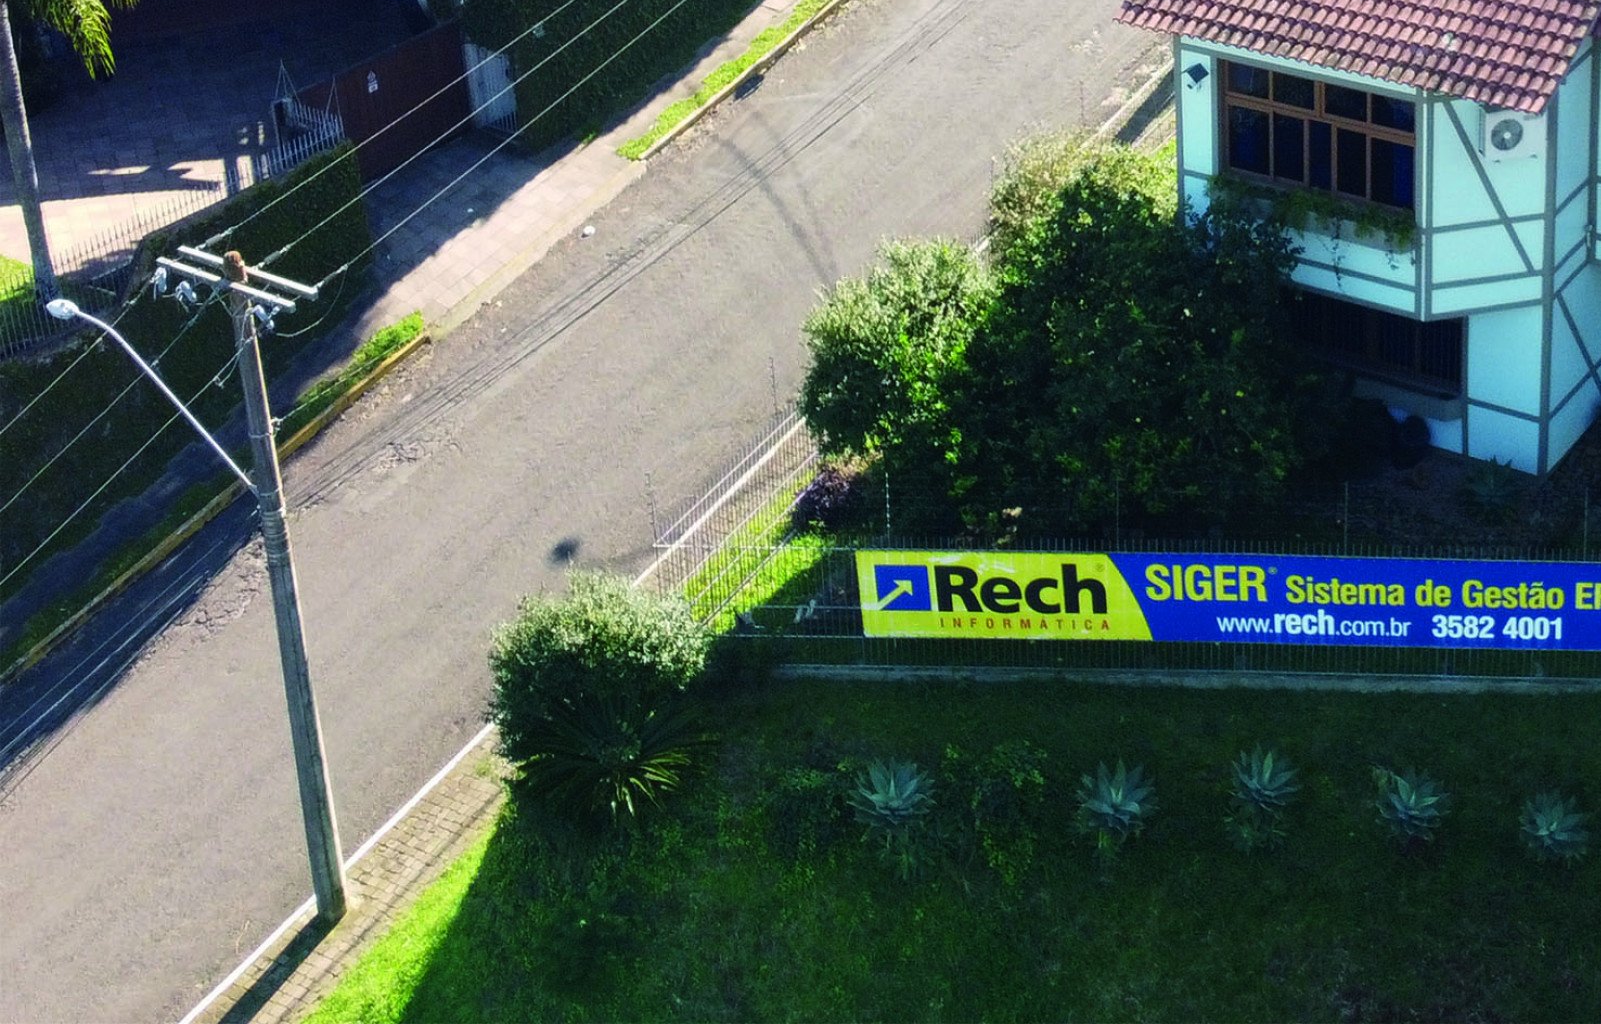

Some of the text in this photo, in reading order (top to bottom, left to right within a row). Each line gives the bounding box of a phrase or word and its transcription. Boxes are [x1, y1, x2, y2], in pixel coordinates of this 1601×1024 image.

[934, 563, 1108, 614] Rech
[1145, 564, 1267, 602] SIGER
[1286, 575, 1406, 606] Sistema
[1415, 579, 1452, 607] de
[1462, 580, 1565, 610] Gestão
[1217, 609, 1563, 640] www.rech.com.br 3582 4001
